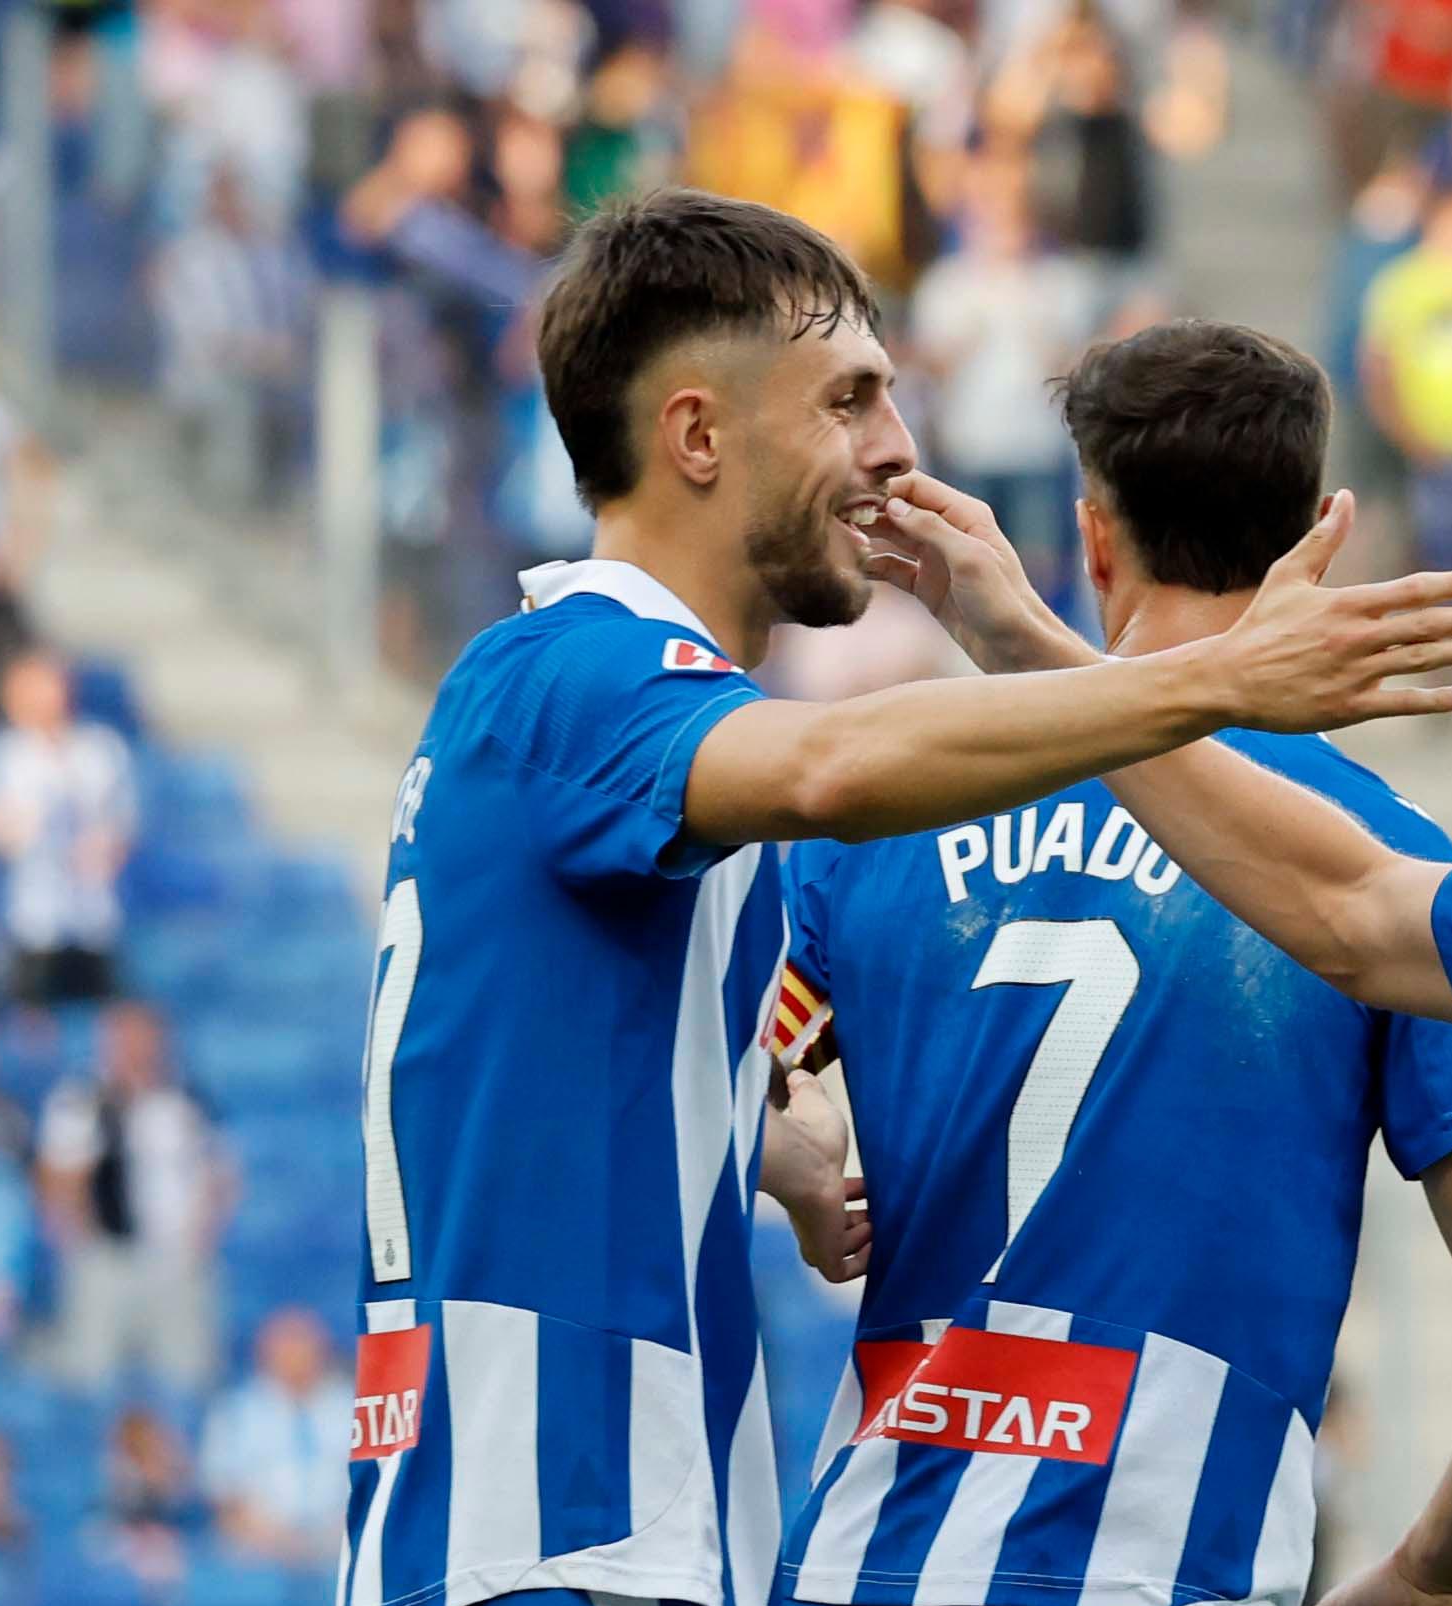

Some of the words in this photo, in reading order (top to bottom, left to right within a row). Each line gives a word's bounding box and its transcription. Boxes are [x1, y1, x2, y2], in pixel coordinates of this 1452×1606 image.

[937, 802, 1183, 903] PUADO
[971, 919, 1140, 1284] 7
[883, 1383, 1093, 1452] STAR
